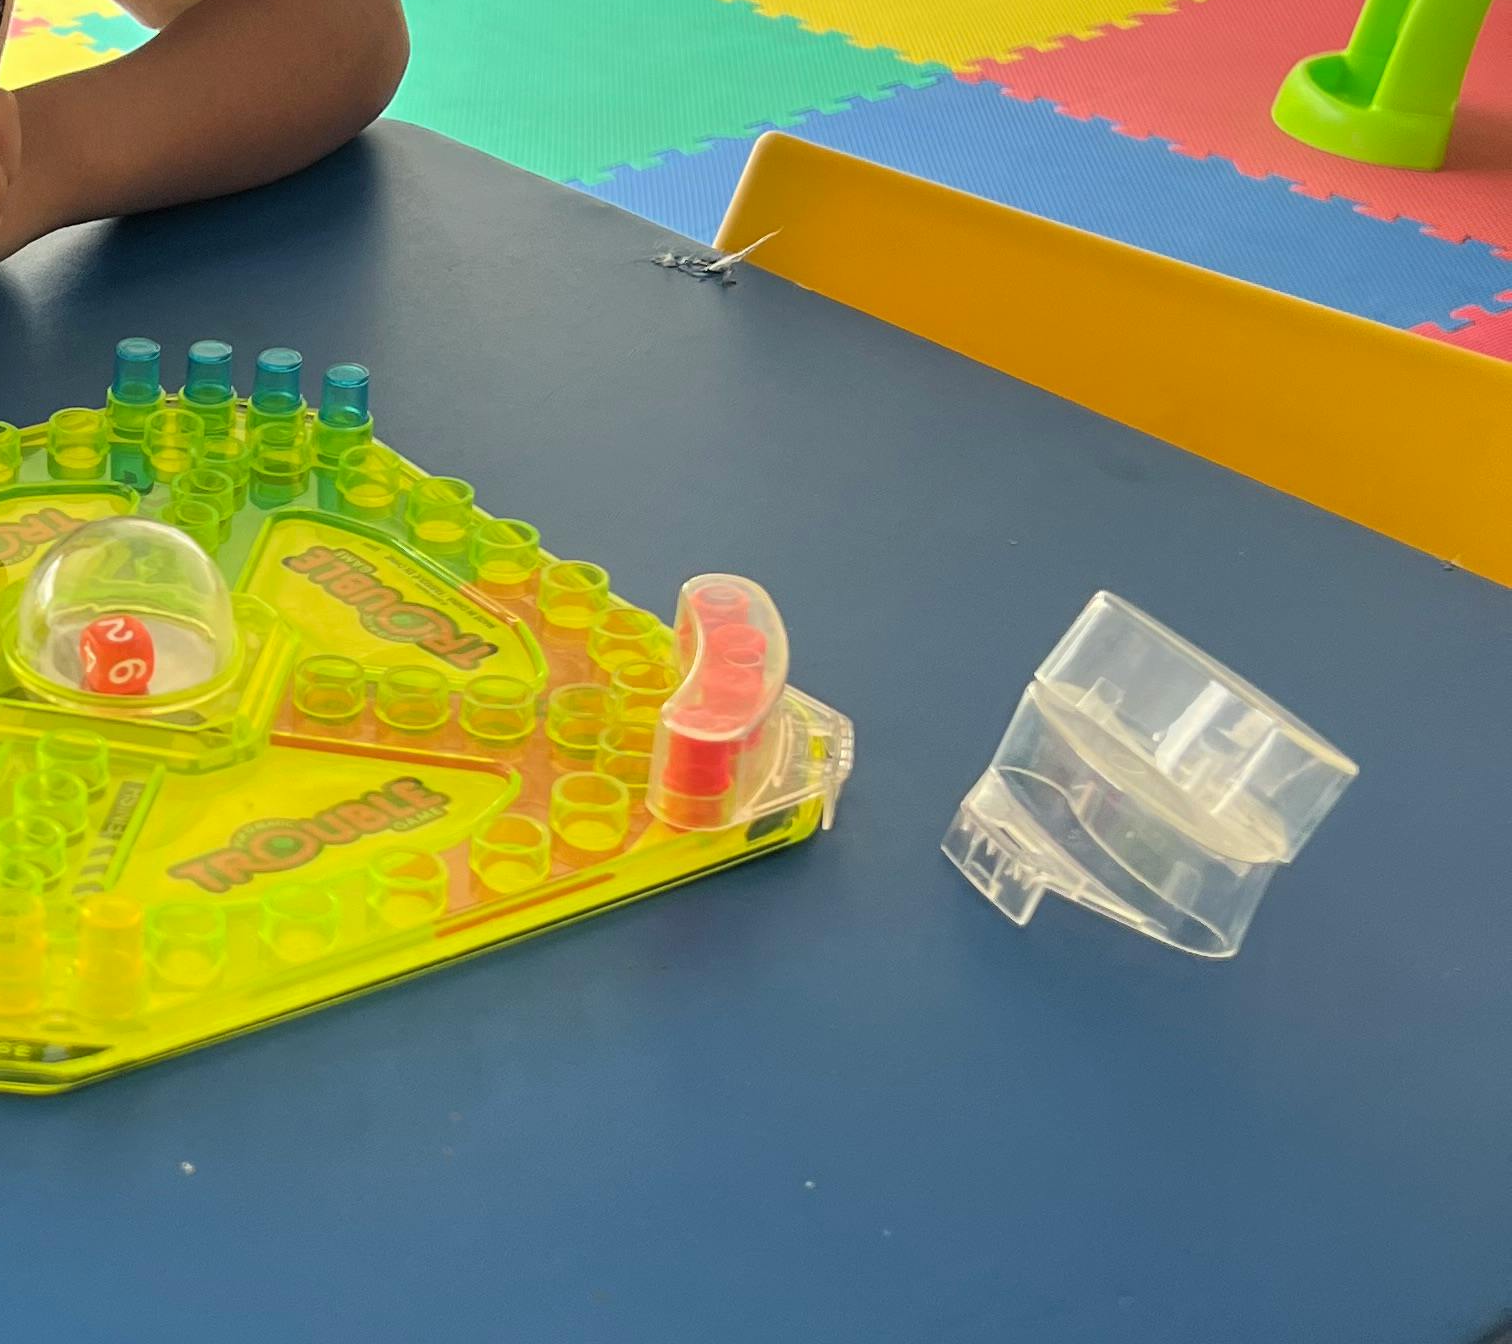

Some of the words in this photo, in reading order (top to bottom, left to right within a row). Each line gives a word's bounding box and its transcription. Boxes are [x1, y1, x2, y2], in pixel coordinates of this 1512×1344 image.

[97, 617, 134, 643] 2
[284, 548, 498, 669] TROUBLE
[109, 658, 147, 685] 6
[170, 778, 450, 892] TROUBLE
